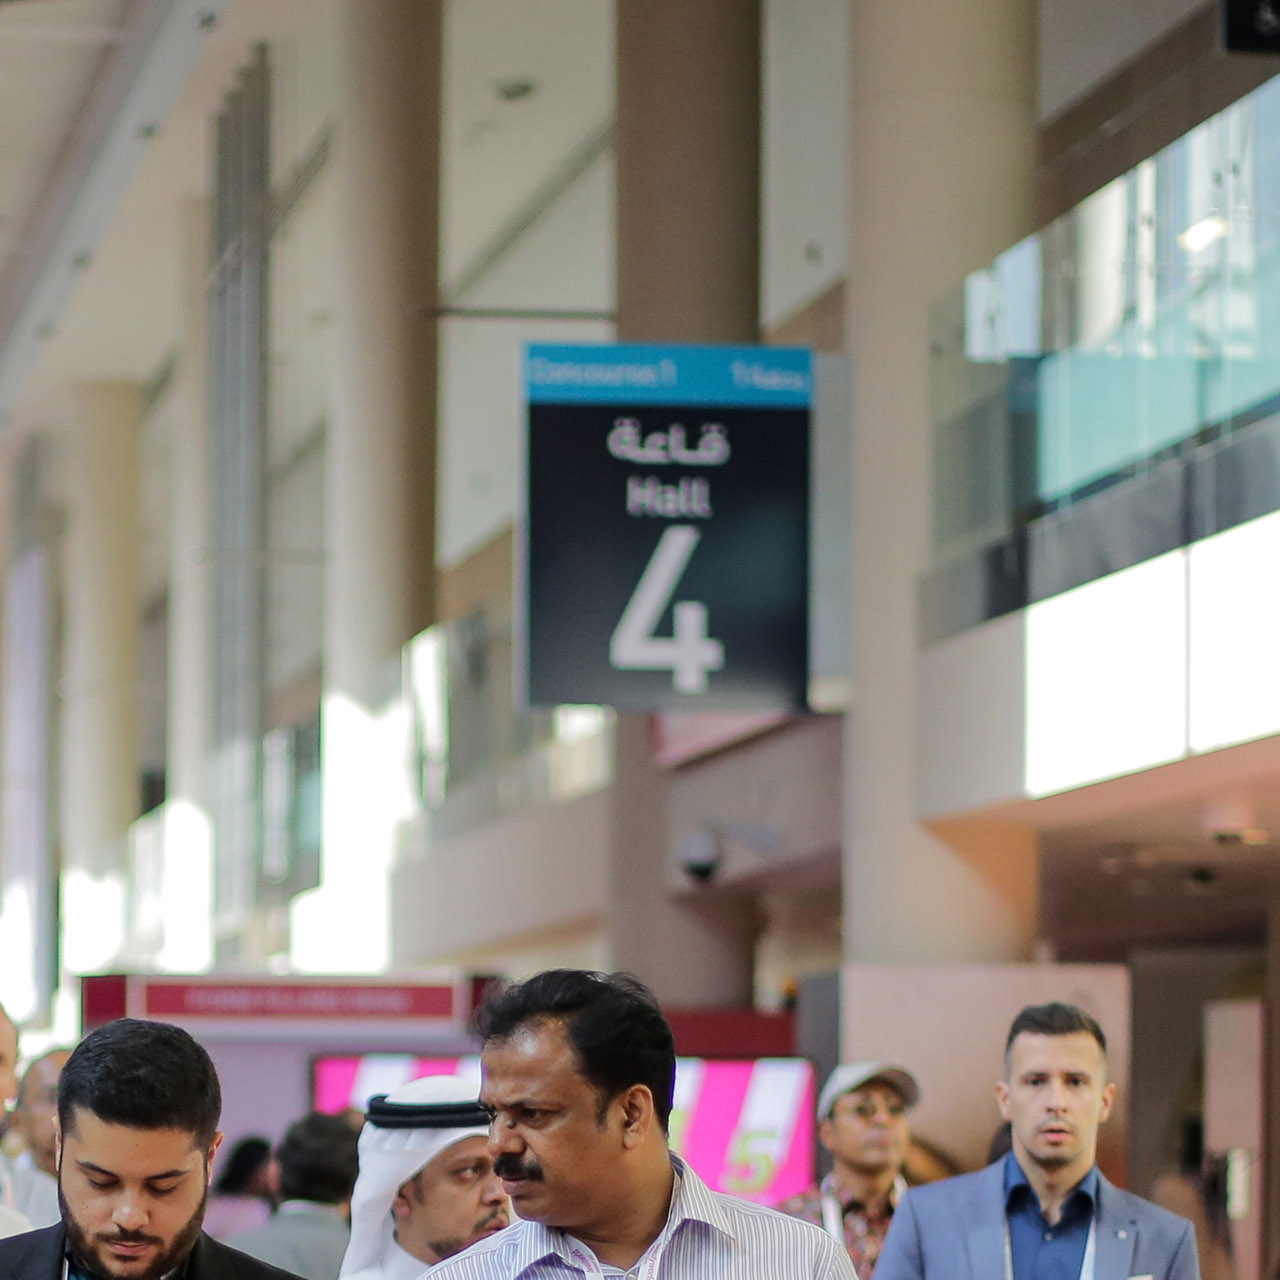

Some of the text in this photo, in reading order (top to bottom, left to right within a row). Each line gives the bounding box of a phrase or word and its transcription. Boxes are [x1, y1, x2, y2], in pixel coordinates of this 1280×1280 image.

[606, 417, 731, 466] قاعة
[626, 475, 713, 519] Hall
[609, 524, 725, 694] 4
